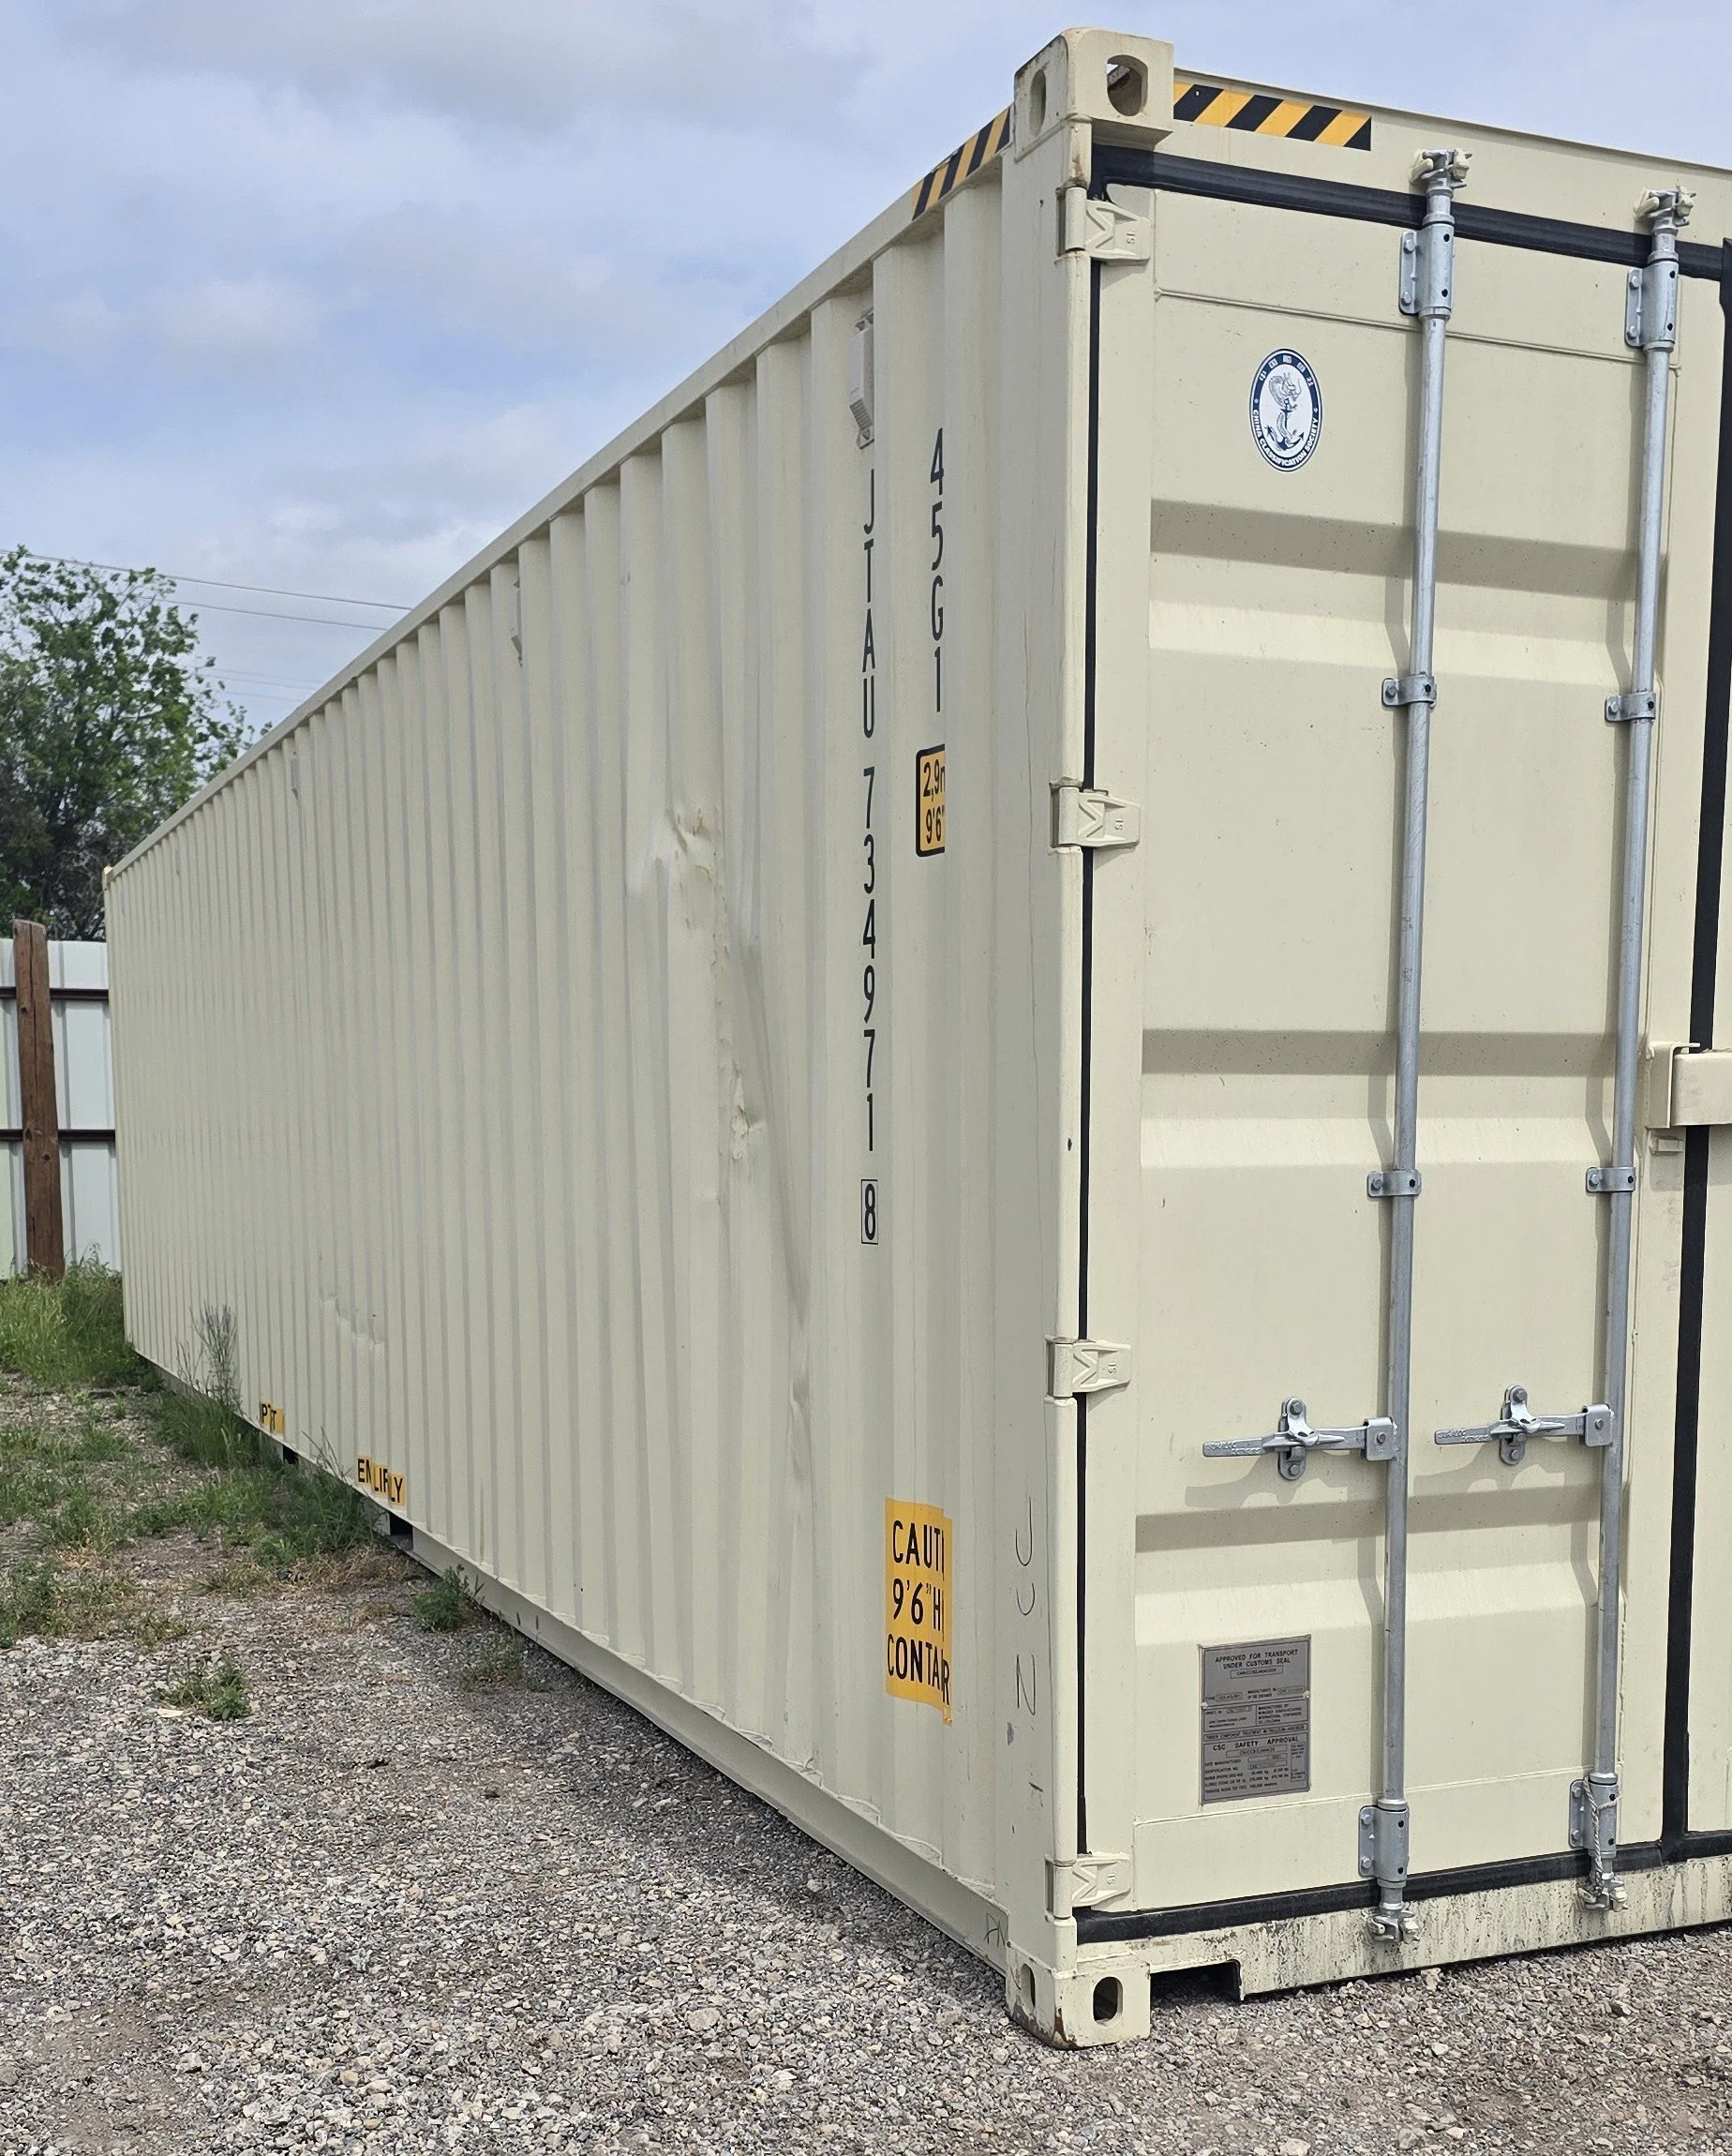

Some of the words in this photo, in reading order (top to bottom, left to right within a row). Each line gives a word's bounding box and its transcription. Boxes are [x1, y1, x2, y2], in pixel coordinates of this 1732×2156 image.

[1253, 410, 1263, 438] CHINA
[930, 427, 945, 712] 45G1
[862, 469, 875, 739] JTAU
[861, 766, 876, 1152] 734971
[892, 1520, 945, 1581] CAUTI
[1215, 1654, 1247, 1663] APPROVED
[1264, 1649, 1299, 1658] TRANSPORT
[1223, 1661, 1243, 1669] UNDER
[1246, 1659, 1275, 1668] CUSTOMS
[1234, 1741, 1259, 1749] SAFETY
[1266, 1736, 1300, 1745] APPROVAL
